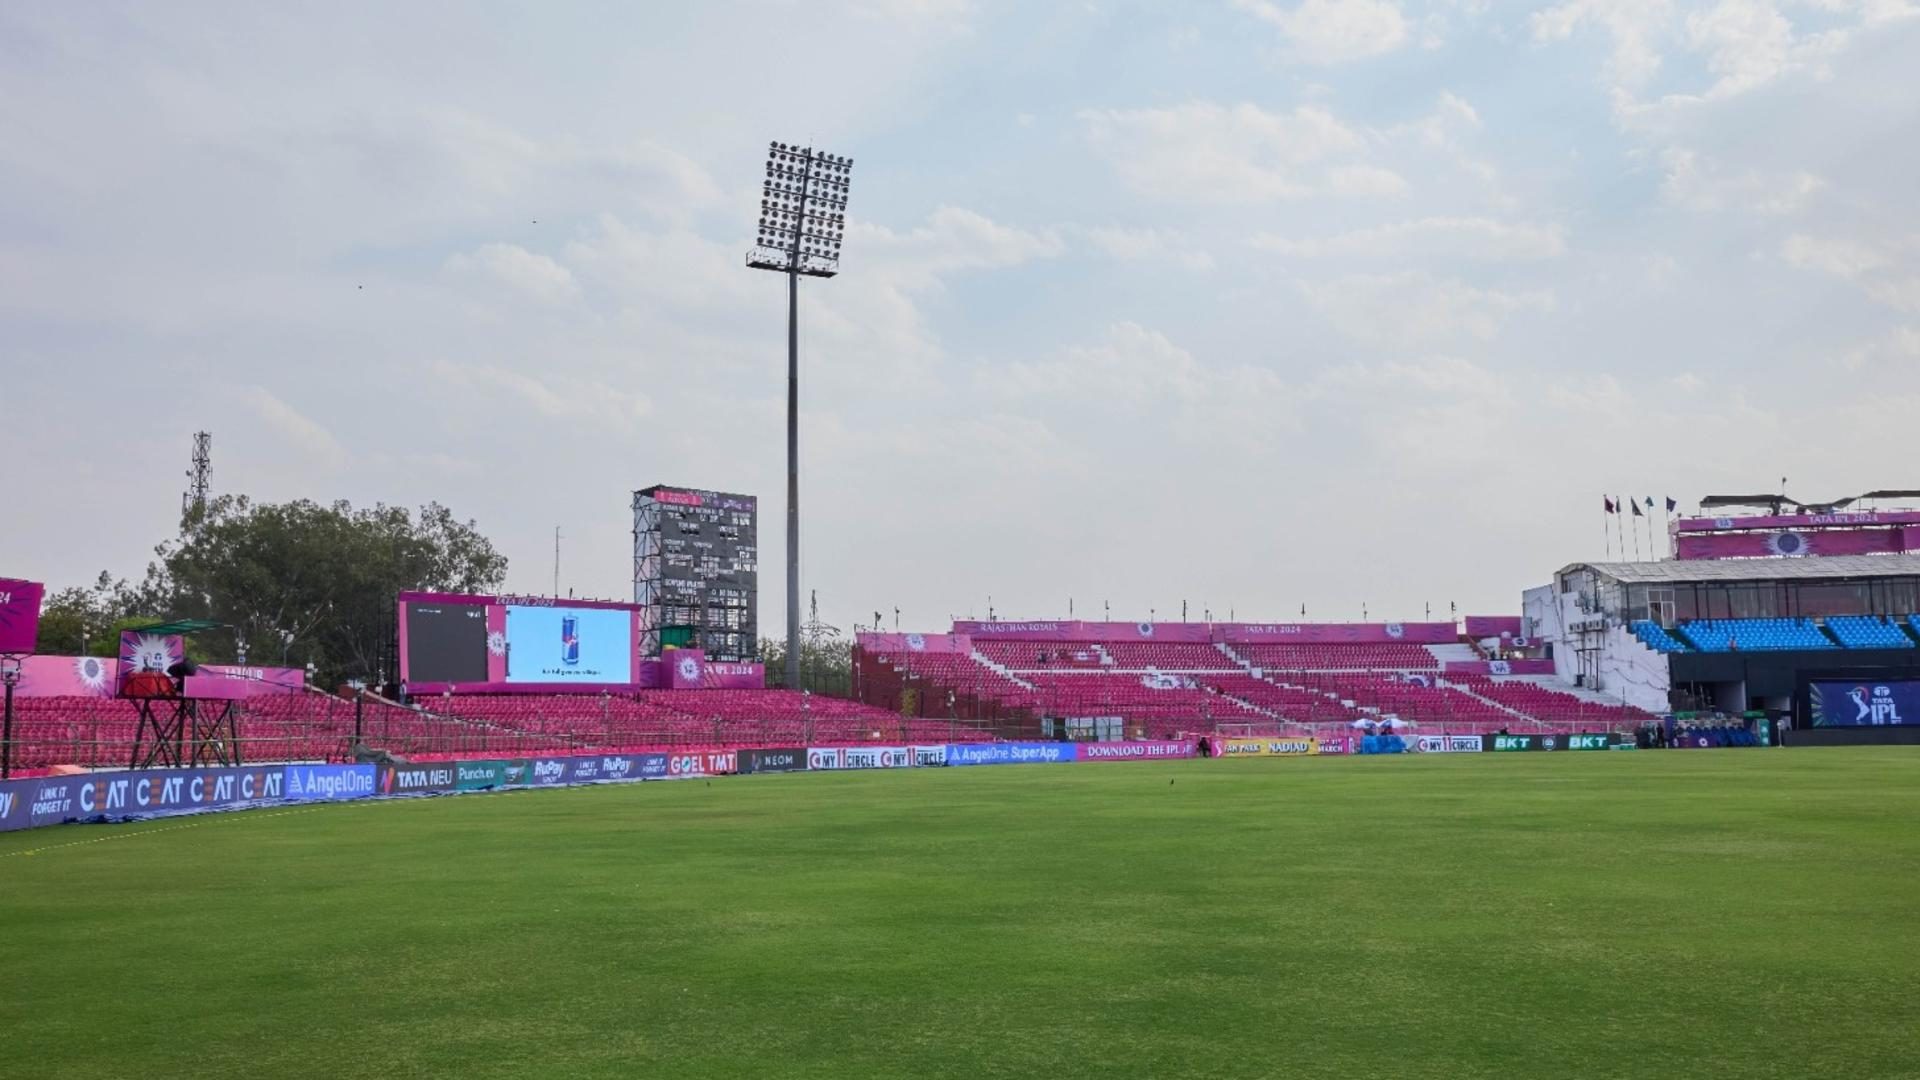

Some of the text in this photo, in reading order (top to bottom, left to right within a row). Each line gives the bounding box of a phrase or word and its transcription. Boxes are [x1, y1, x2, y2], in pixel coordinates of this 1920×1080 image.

[1809, 516, 1834, 524] TATA
[1853, 514, 1878, 522] 2024
[980, 623, 1058, 633] RAJASTHAN ROYALS
[1245, 625, 1263, 634] TATA
[1280, 625, 1301, 634] 2024
[1870, 703, 1902, 725] IPL
[1088, 745, 1144, 757] DOWNLOAD
[1147, 745, 1164, 755] THE
[1166, 744, 1180, 754] IPL
[1495, 737, 1530, 749] BKT
[1569, 737, 1607, 749] BKT
[765, 755, 793, 765] NEOM
[962, 746, 1059, 763] AngelOne SuperApp
[534, 761, 565, 777] RuPay
[602, 757, 631, 774] RuPay
[671, 754, 735, 773] GOEL TMT
[397, 769, 453, 788] TATA NEU
[458, 767, 495, 780] Punch.ev
[190, 775, 235, 803] CEAT
[242, 772, 283, 799] CEAT
[305, 768, 373, 797] AngelOne
[59, 786, 67, 798] IT
[80, 780, 128, 812] CEAT
[136, 777, 184, 806] CEAT
[32, 799, 71, 815] FORGET IT
